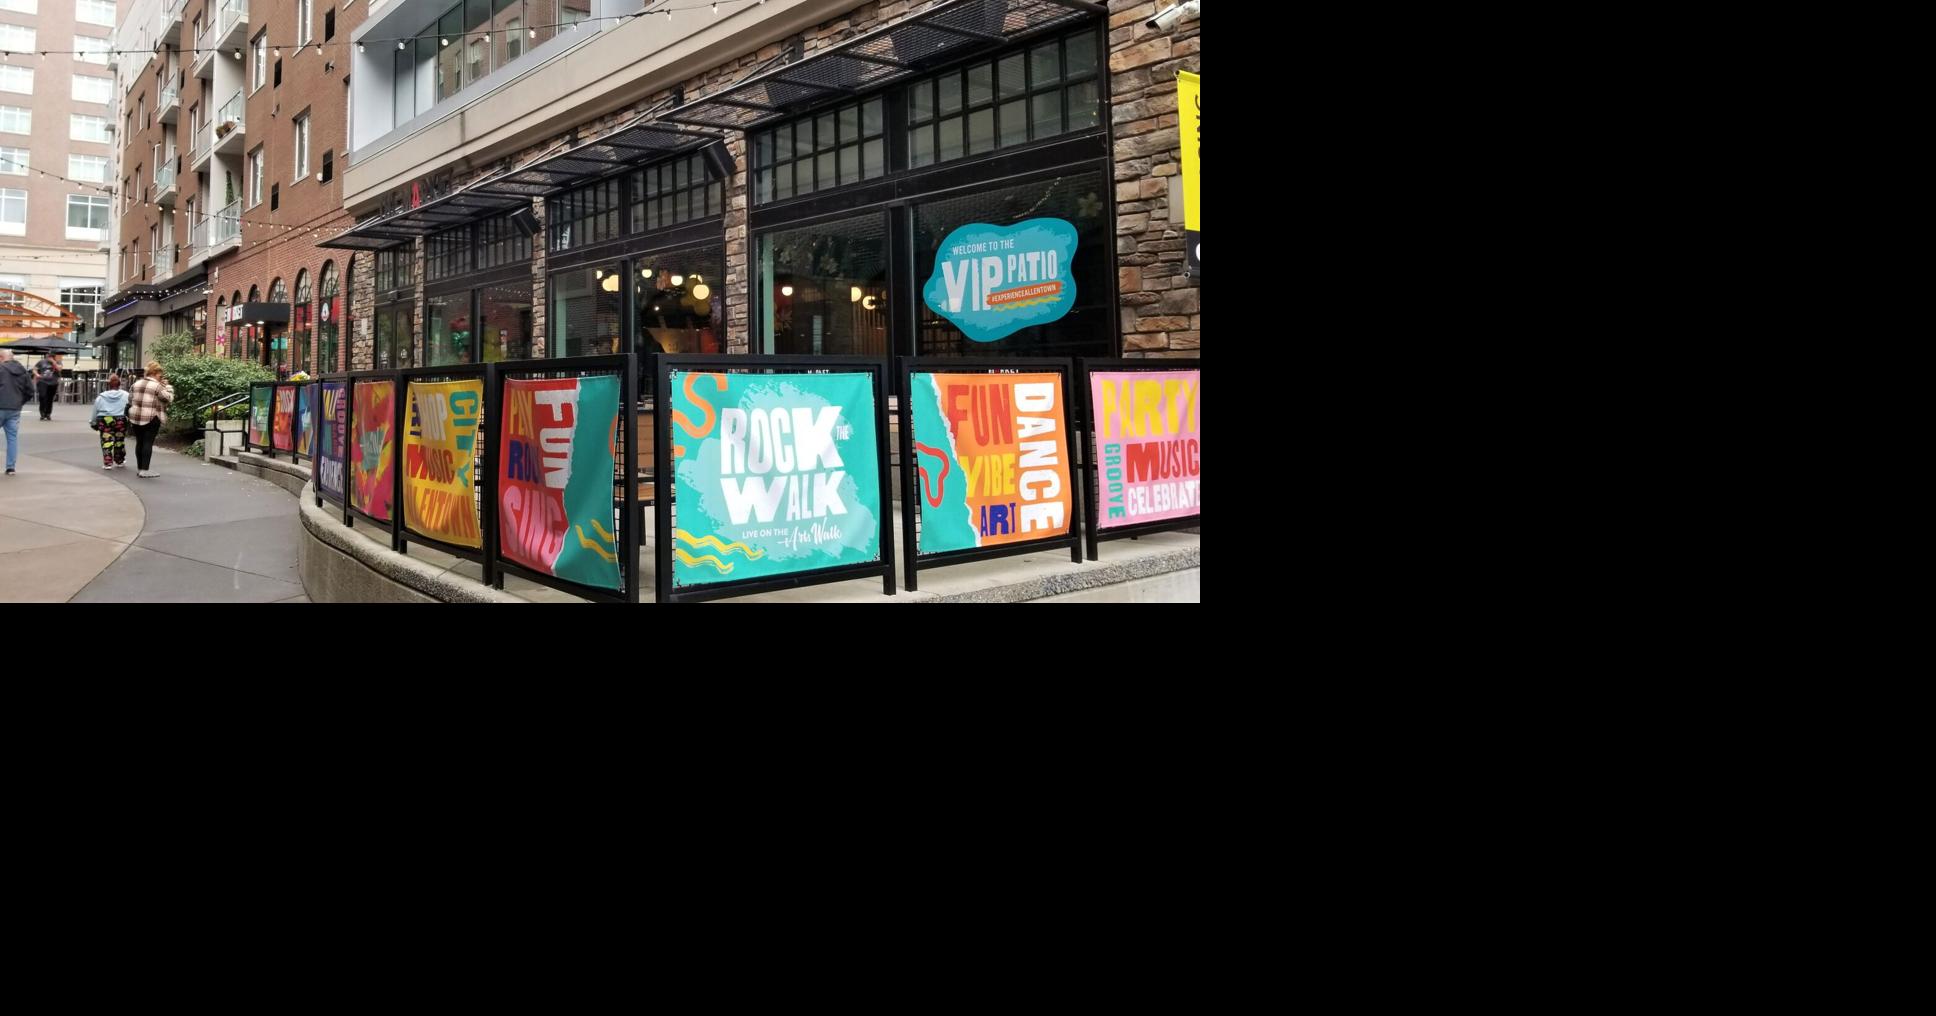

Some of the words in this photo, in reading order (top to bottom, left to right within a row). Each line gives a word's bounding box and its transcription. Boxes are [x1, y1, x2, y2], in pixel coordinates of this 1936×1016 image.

[952, 242, 987, 256] WELCOME
[988, 240, 998, 251] TO
[999, 238, 1015, 249] THE
[941, 255, 1003, 313] VIP
[1007, 249, 1058, 283] PATIO
[991, 284, 1056, 303] #EXPERIENCEALLENTOWN
[836, 424, 850, 441] THE
[947, 383, 1014, 447] FUN
[1101, 378, 1199, 438] PARTY
[406, 443, 455, 485] MUSIC
[450, 390, 478, 488] CITY
[534, 388, 580, 489] FUN
[720, 405, 844, 474] ROCK
[1014, 382, 1064, 534] DANCE
[1126, 438, 1200, 483] MUSIC
[720, 470, 848, 525] WALK
[960, 452, 1016, 498] VIBE
[1104, 443, 1127, 520] GROOVE
[503, 485, 563, 565] SING
[742, 530, 758, 539] LIVE
[760, 529, 772, 537] ON
[774, 527, 788, 536] THE
[776, 526, 811, 551] Arts
[811, 516, 842, 546] Walk
[980, 502, 1017, 537] ART
